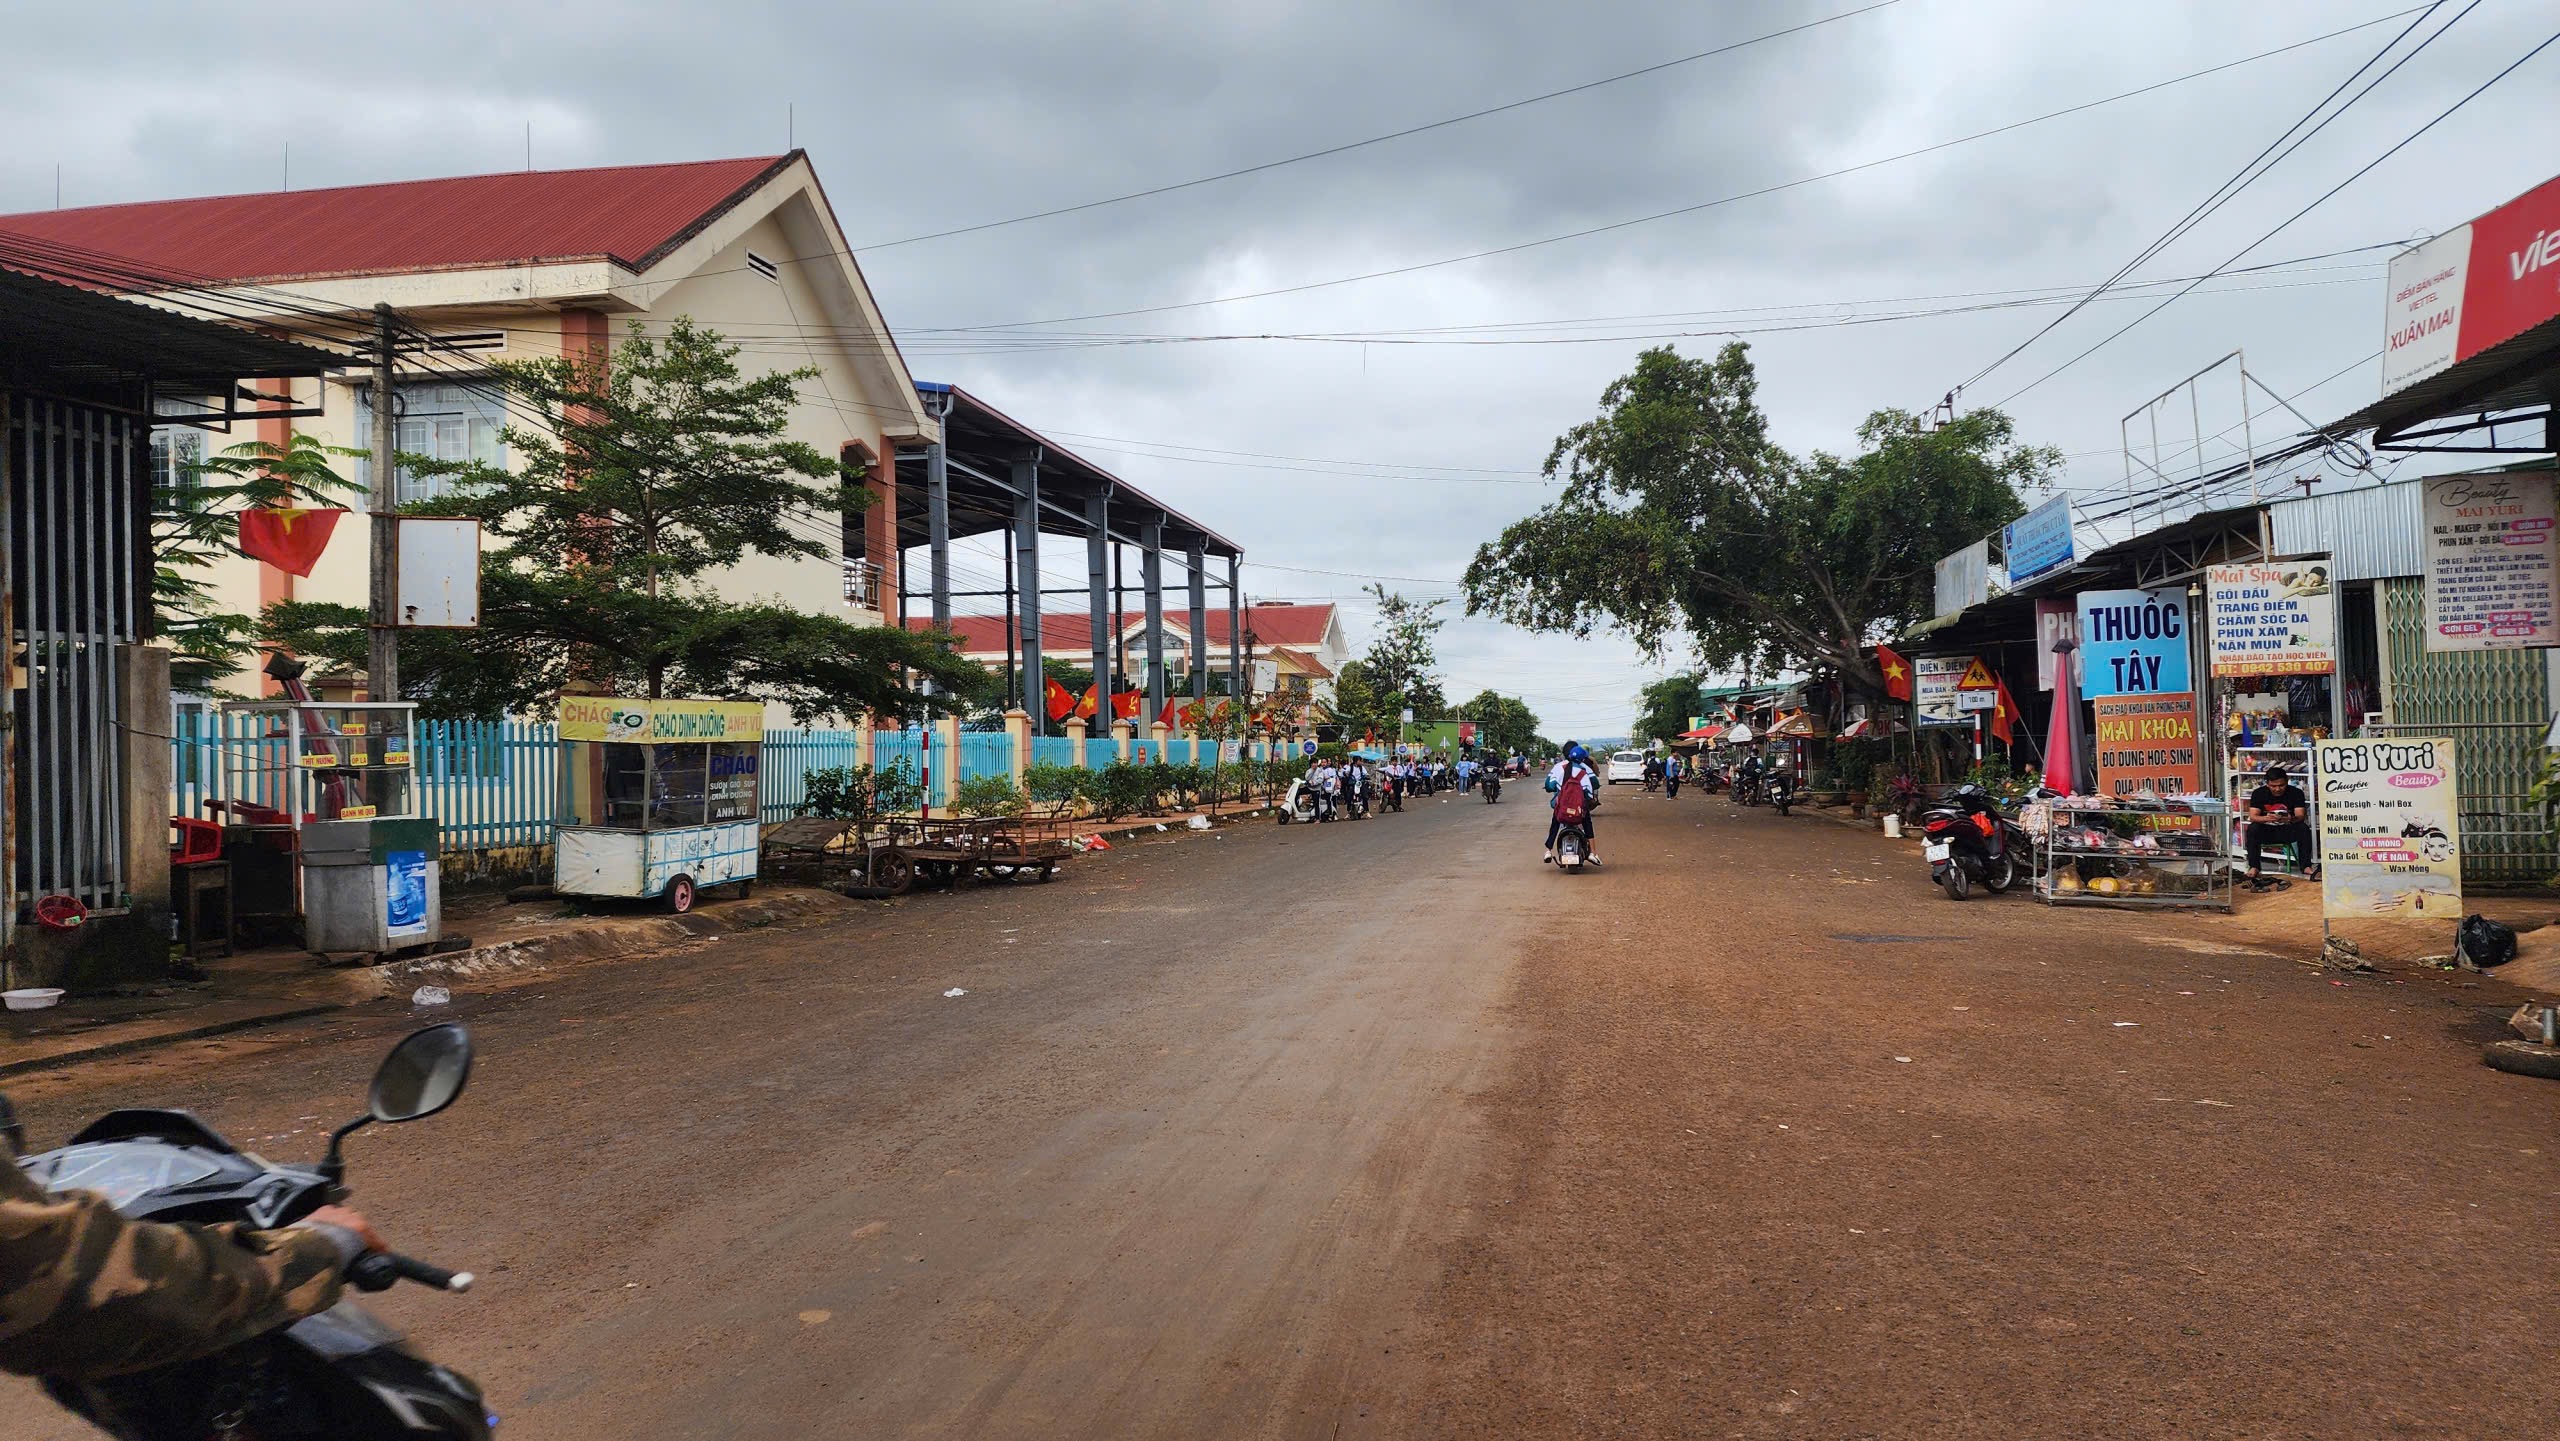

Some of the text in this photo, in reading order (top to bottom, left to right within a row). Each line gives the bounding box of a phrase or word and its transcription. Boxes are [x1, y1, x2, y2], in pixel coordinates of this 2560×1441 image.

[2409, 292, 2439, 312] VIETTEL
[2391, 306, 2455, 352] XUÂN MAI
[2430, 479, 2520, 507] Beauty
[2456, 505, 2524, 518] MAI YURI
[2433, 525, 2448, 535] NAIL
[2455, 523, 2482, 534] MAKEUP
[2439, 538, 2457, 547] PHUN
[2214, 567, 2283, 586] Mai Spa
[2216, 586, 2269, 602] GỘI ĐẦU
[2217, 599, 2298, 613] TRANG ĐIỂM
[2089, 591, 2181, 642] THUỐC
[2217, 613, 2310, 626] CHĂM SÓC DA
[2218, 628, 2254, 639] PHUN
[2444, 624, 2462, 633] SƠN
[2463, 623, 2479, 632] GEL
[2251, 640, 2283, 651] MỤN
[2306, 651, 2327, 660] VIÊN
[1946, 660, 1964, 673] ĐIỆN
[2110, 649, 2162, 693] TÂY
[2306, 661, 2329, 671] 407
[565, 702, 613, 724] CHÁO
[2129, 702, 2143, 714] KHOA
[653, 707, 677, 738] CHÁO
[679, 713, 697, 738] DINH
[699, 709, 725, 737] DƯỠNG
[727, 715, 747, 732] ANH
[2101, 718, 2192, 742] MAI KHOA
[711, 751, 757, 775] CHÁO
[2102, 747, 2193, 769] ĐỒ DÙNG HỌC SINH
[2323, 742, 2435, 773] Mai Yuri
[2115, 774, 2184, 796] QUÀ NIỆM
[2325, 780, 2368, 793] Chuyên
[2395, 775, 2435, 787] Beauty
[712, 792, 728, 800] DINH
[2326, 800, 2342, 808] Nail
[716, 806, 734, 819] ANH
[2326, 814, 2358, 822] Makeup
[2343, 826, 2353, 834] Mi
[2361, 824, 2376, 834] Uốn
[2377, 839, 2401, 847] MÓNG
[2390, 851, 2410, 860] NAIL
[2389, 864, 2430, 873] Wax Nóng
